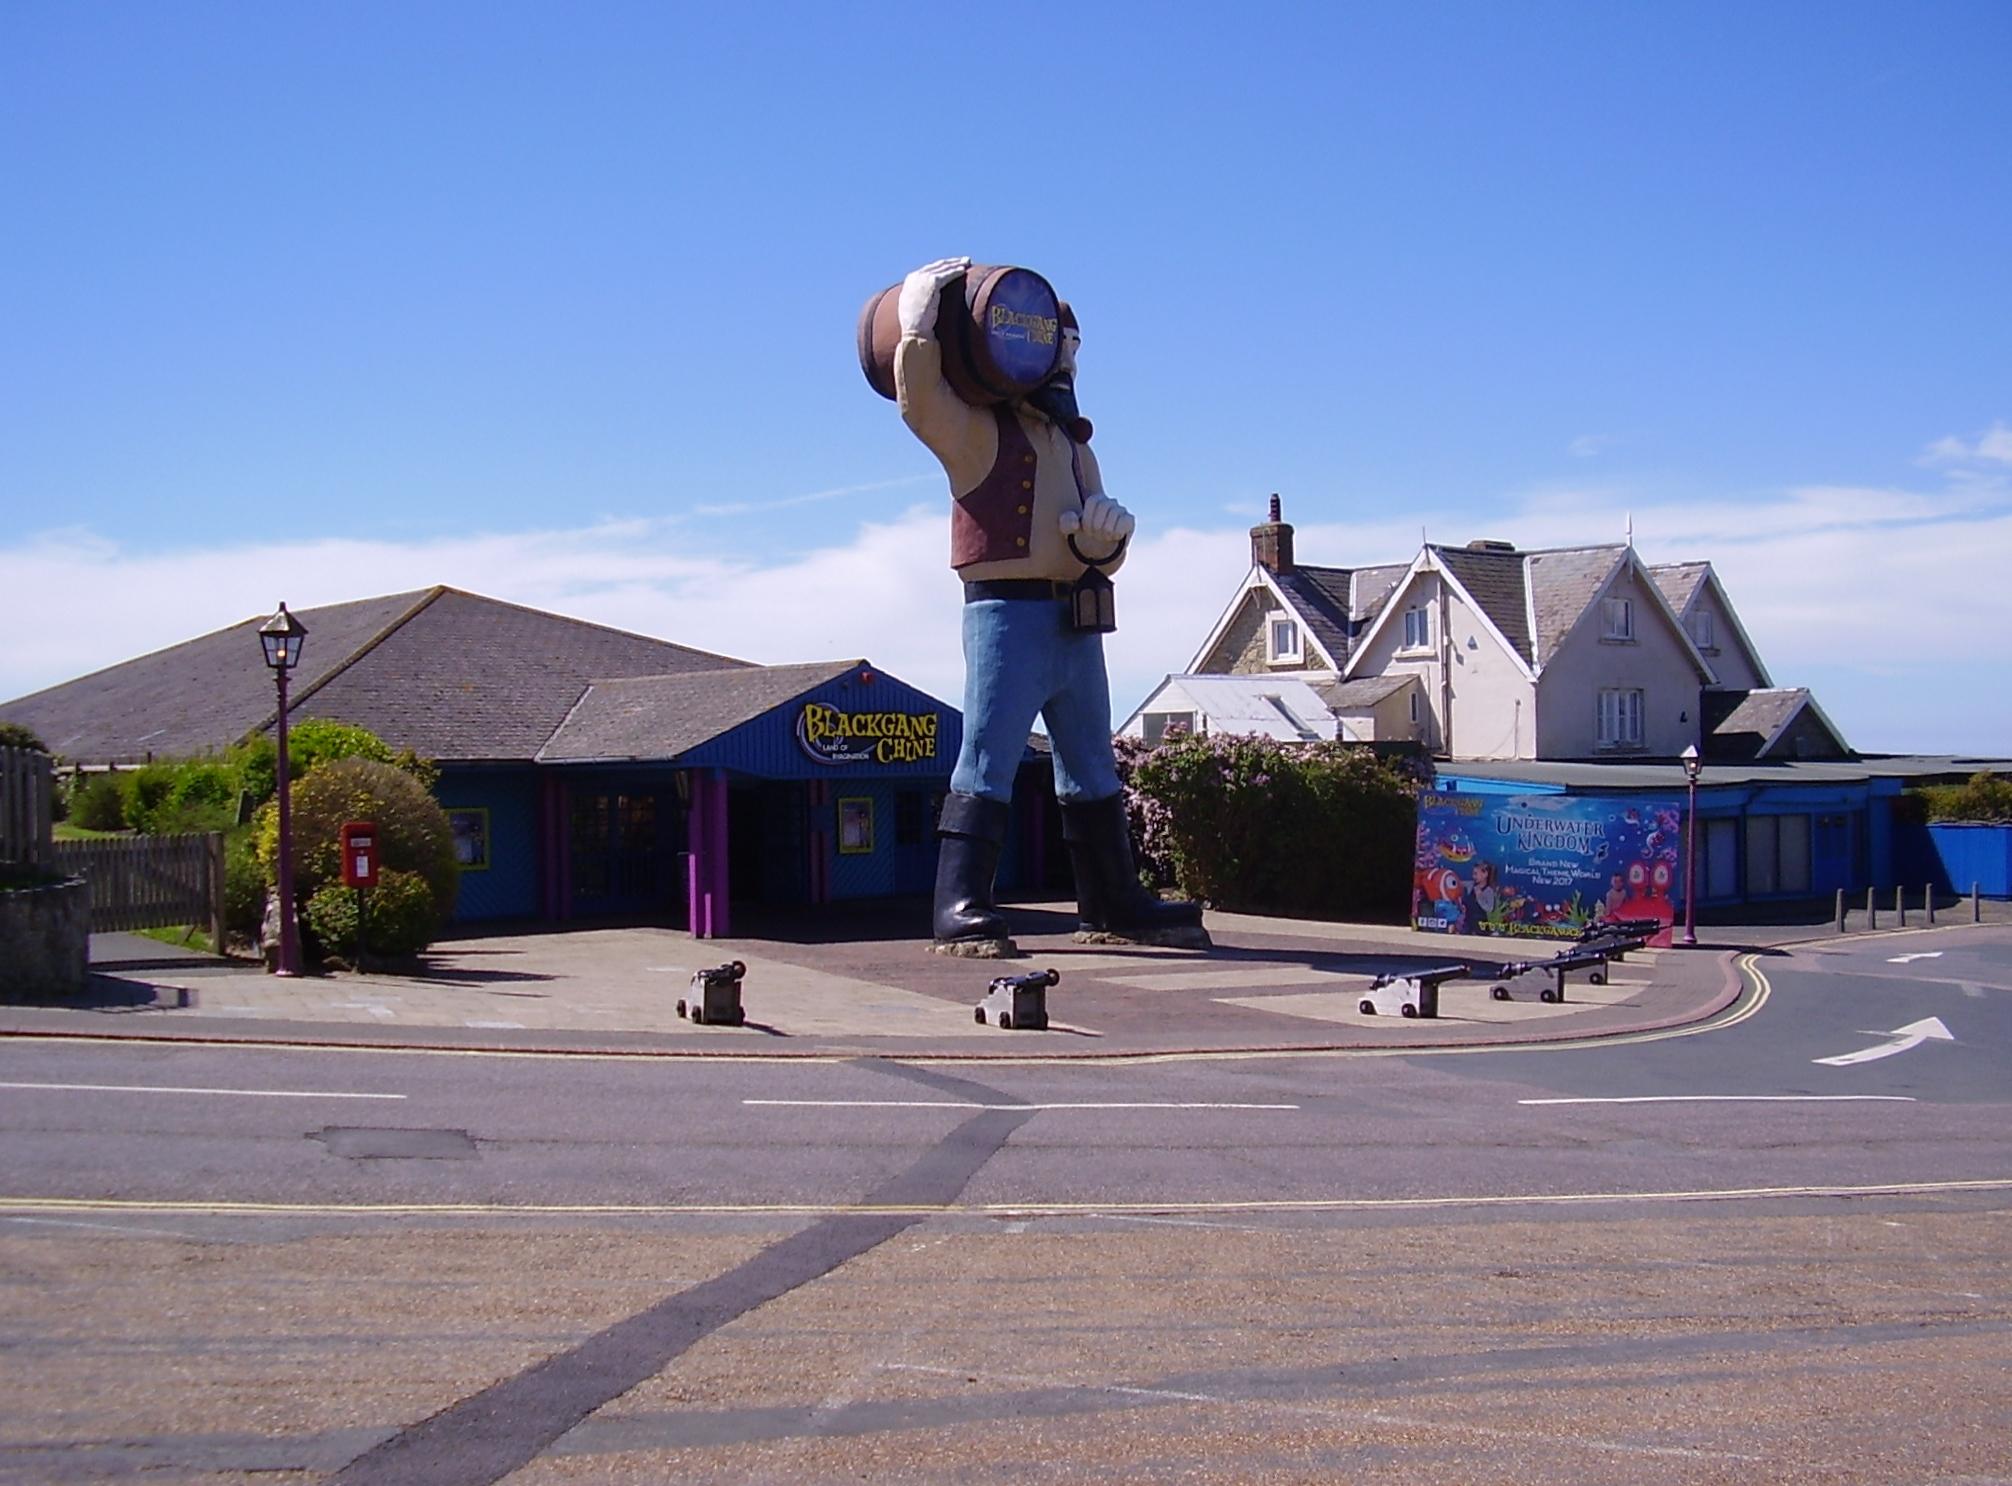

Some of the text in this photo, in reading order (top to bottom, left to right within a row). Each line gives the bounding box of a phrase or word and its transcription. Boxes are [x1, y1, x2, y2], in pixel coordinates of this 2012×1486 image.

[805, 704, 938, 742] BLACKGANG
[877, 737, 935, 763] CHINE
[1495, 814, 1606, 839] UNDERWATER
[1517, 831, 1595, 855] KINGDOM
[1560, 859, 1580, 869] NEW
[1532, 876, 1573, 887] NEW 2017
